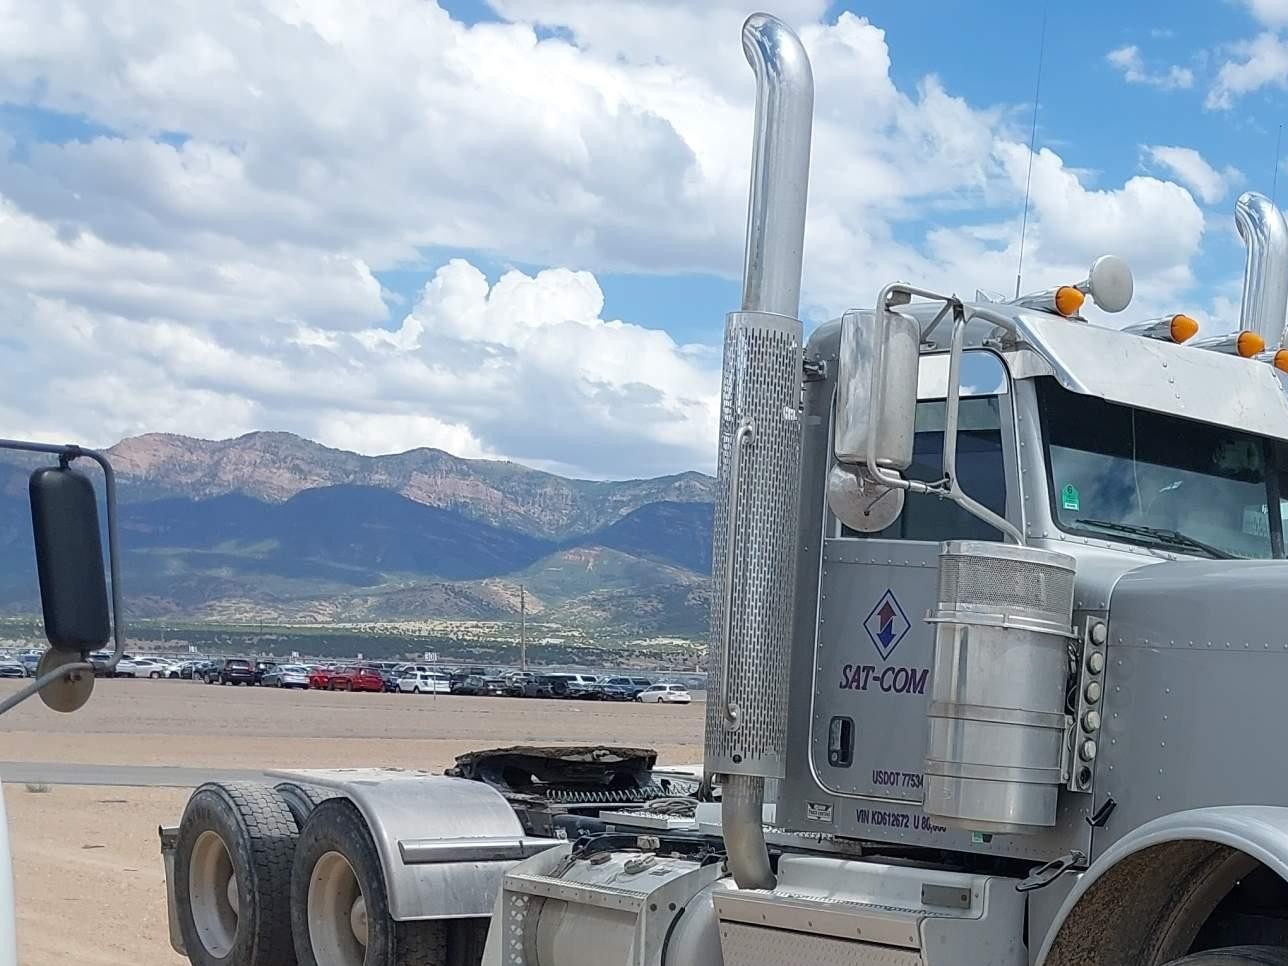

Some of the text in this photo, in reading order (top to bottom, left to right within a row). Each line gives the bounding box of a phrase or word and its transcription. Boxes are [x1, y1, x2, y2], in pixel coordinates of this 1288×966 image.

[838, 664, 930, 695] SAT-COM
[872, 769, 901, 787] USDOT
[856, 808, 870, 825] VIN
